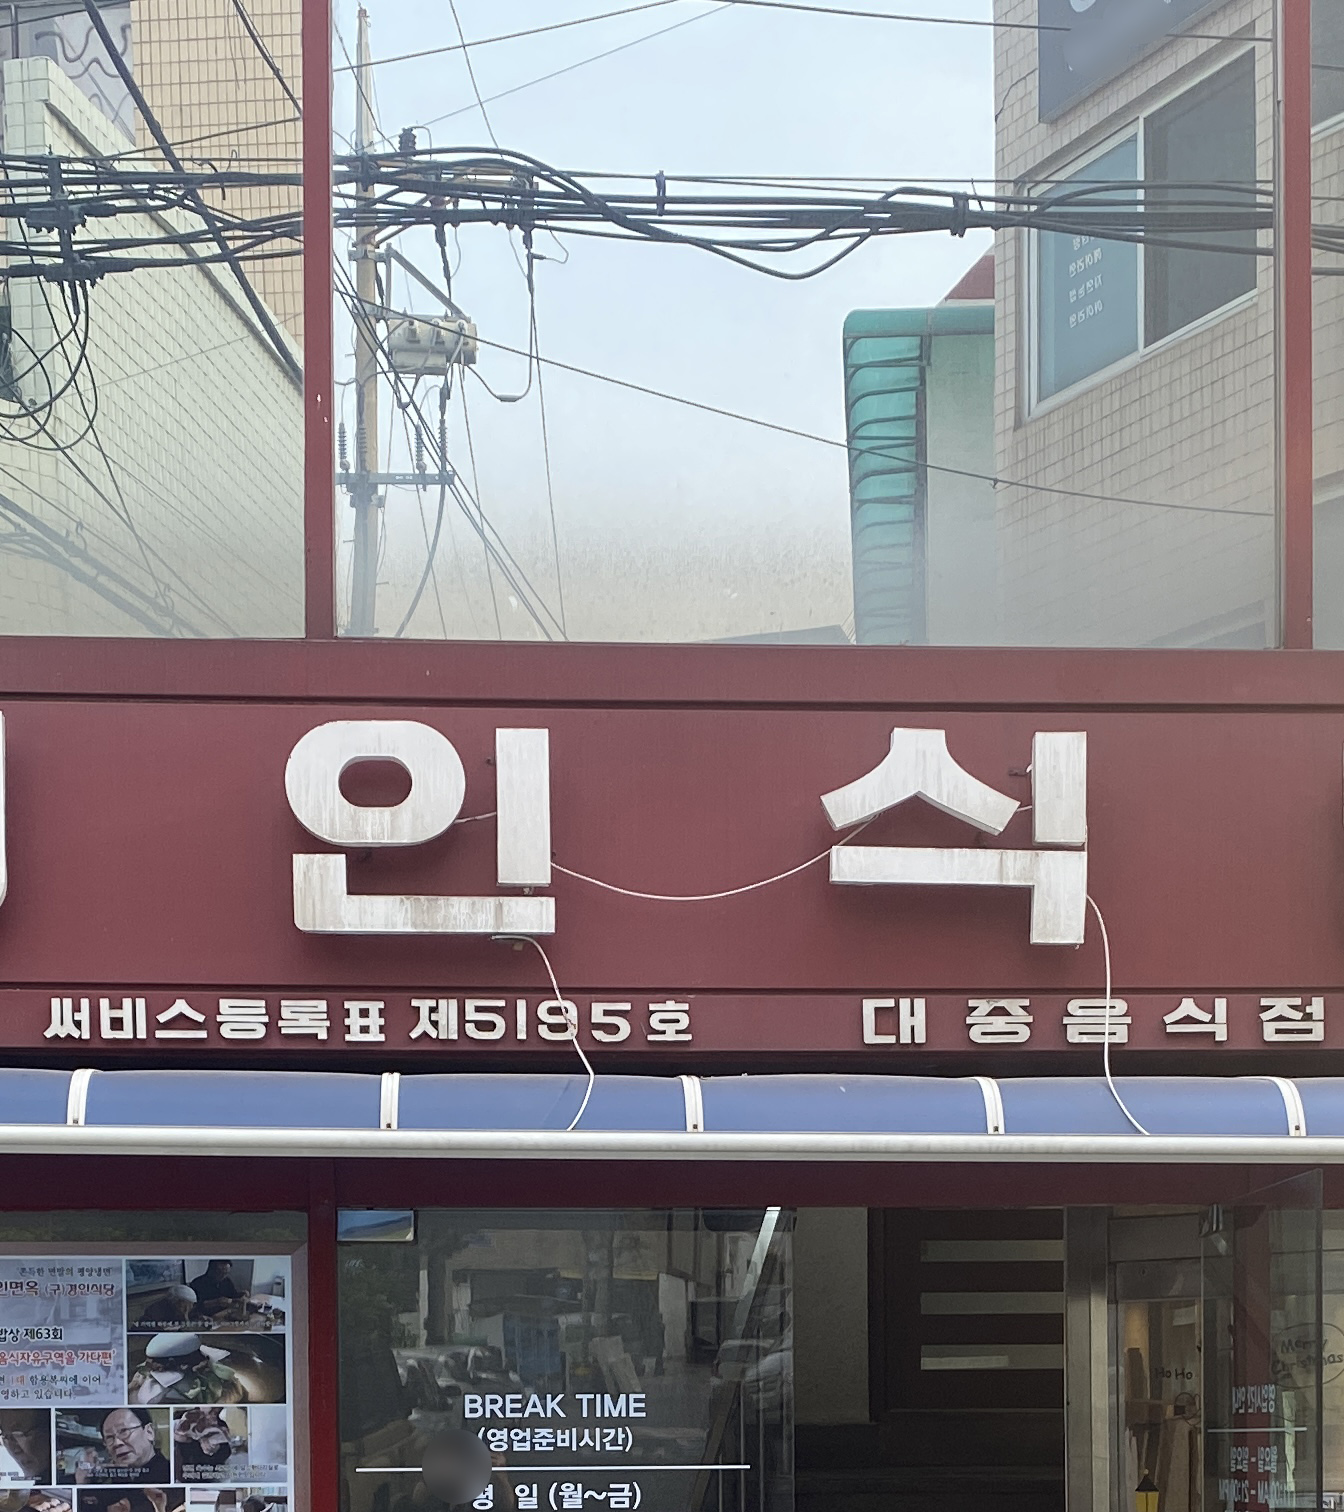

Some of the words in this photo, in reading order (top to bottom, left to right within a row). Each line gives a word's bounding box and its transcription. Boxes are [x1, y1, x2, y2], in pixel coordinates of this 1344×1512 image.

[43, 998, 387, 1043] 써비스등록표
[861, 997, 1327, 1045] 대중음식점
[45, 1282, 115, 1298] (구)경인식당
[23, 1326, 64, 1342] 제63회
[1174, 1367, 1193, 1380] Ho
[463, 1393, 565, 1420] BREAK
[576, 1393, 647, 1418] TIME
[478, 1426, 634, 1453] (영업준비시간)
[549, 1481, 642, 1510] (월~금)
